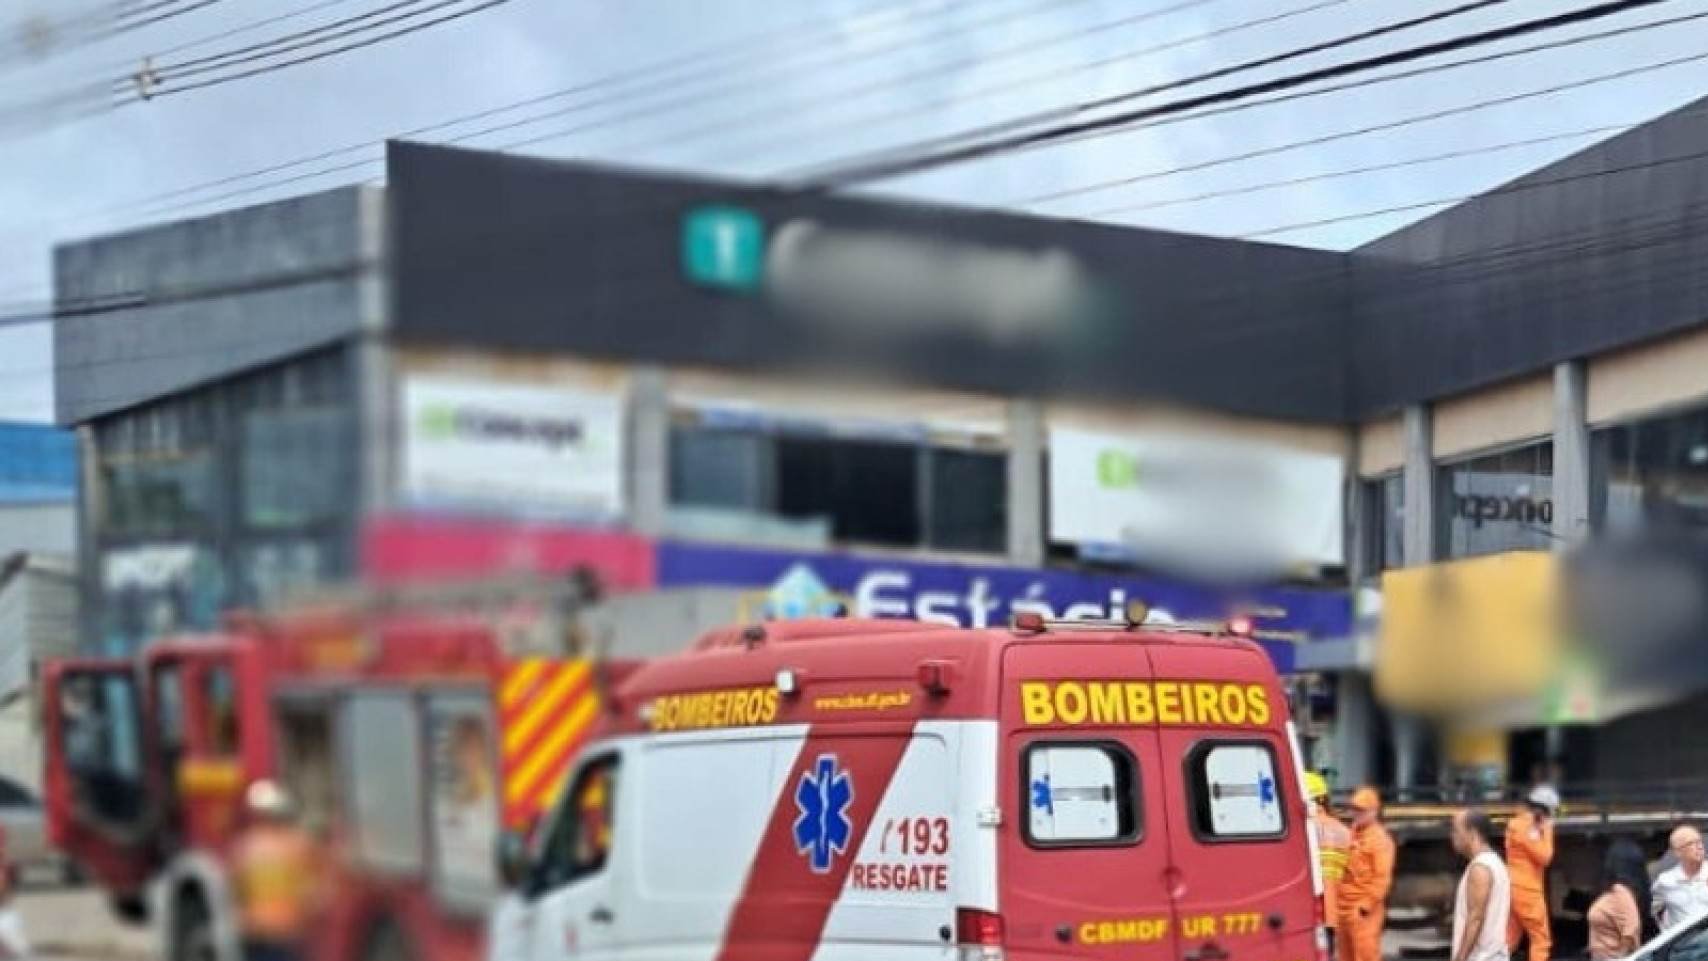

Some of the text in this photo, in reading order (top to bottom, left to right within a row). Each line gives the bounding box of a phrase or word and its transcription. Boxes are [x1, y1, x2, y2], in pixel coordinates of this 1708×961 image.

[654, 688, 781, 731] BOMBEIROS
[1021, 680, 1270, 725] BOMBEIROS
[897, 817, 949, 855] 193
[853, 864, 947, 891] RESGATE
[1079, 912, 1264, 943] CBMDF UR 777
